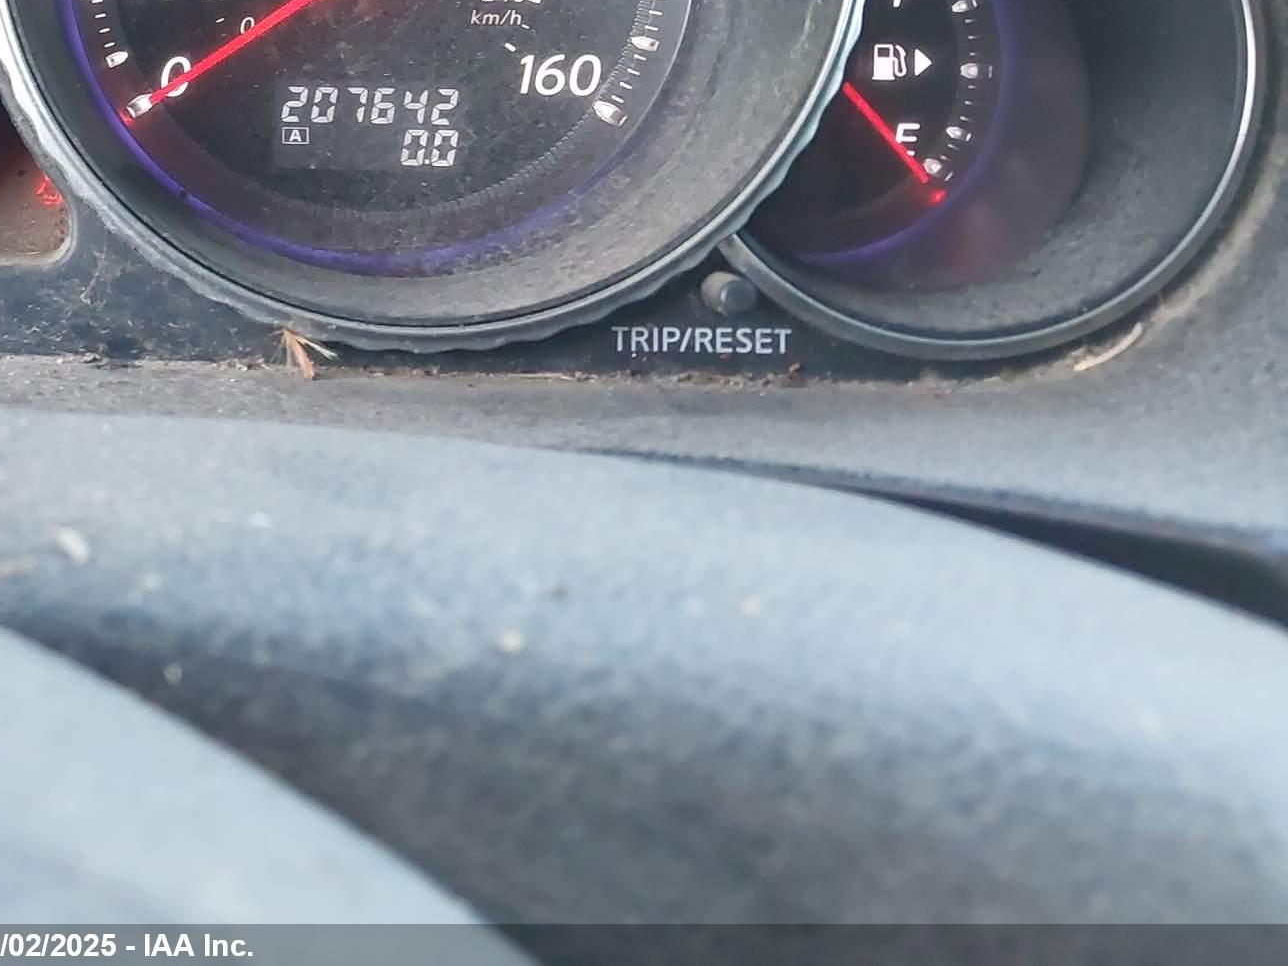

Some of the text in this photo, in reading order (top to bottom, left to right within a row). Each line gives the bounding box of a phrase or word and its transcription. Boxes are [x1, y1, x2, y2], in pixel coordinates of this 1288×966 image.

[239, 16, 255, 37] 0
[470, 8, 523, 27] km/h
[160, 56, 192, 98] 0
[518, 54, 602, 97] 160
[281, 87, 460, 126] 207642
[401, 130, 459, 167] 0.0
[895, 122, 921, 156] E
[612, 326, 792, 356] TRIP/RESET
